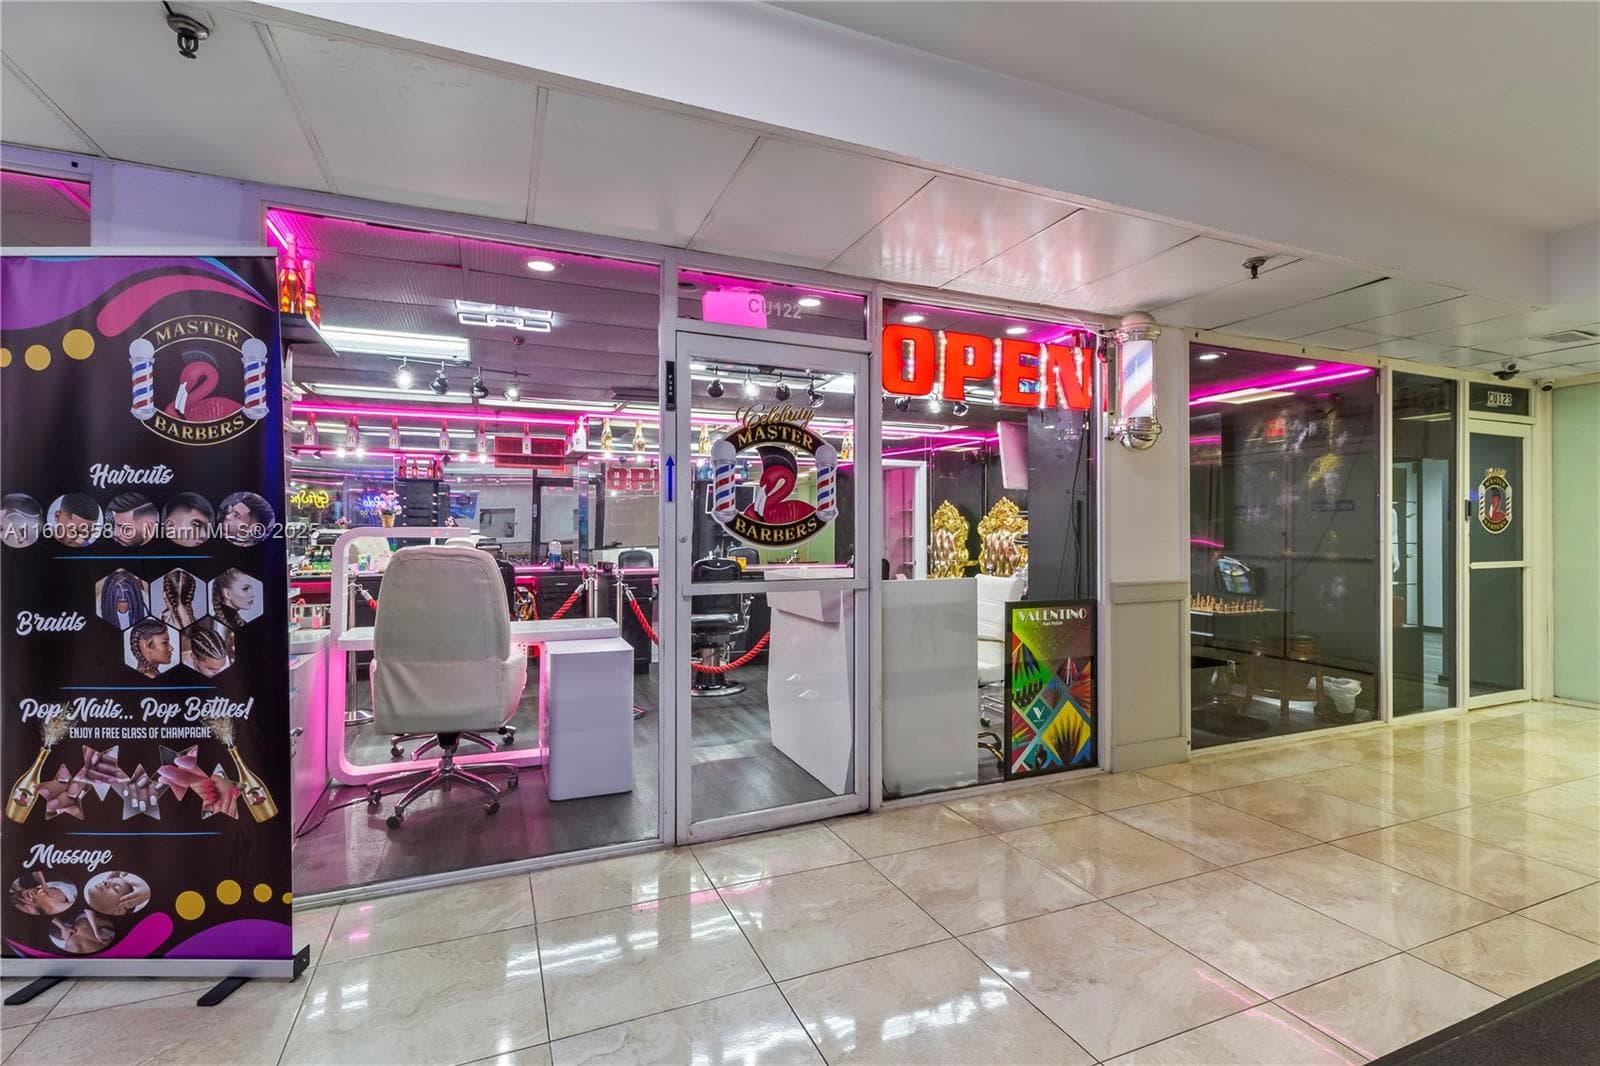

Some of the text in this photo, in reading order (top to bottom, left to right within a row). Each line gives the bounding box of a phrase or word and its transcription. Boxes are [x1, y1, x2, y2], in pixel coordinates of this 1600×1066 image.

[748, 298, 802, 320] CU122
[155, 319, 240, 345] MASTER
[882, 323, 1092, 411] OPEN
[154, 415, 245, 441] BARBERS
[735, 402, 815, 430] Celebrity
[736, 425, 815, 450] MASTER
[89, 462, 174, 488] Haircuts
[735, 517, 818, 542] BARBERS
[15, 610, 87, 636] Braids
[1017, 608, 1088, 621] VALENTINO
[19, 698, 63, 724] Pop
[140, 697, 181, 724] Pop
[183, 696, 255, 721] Bottles!
[69, 726, 212, 739] ENJOY A FREE GLASS OF CHAMPAGNE
[23, 842, 113, 872] Massage
